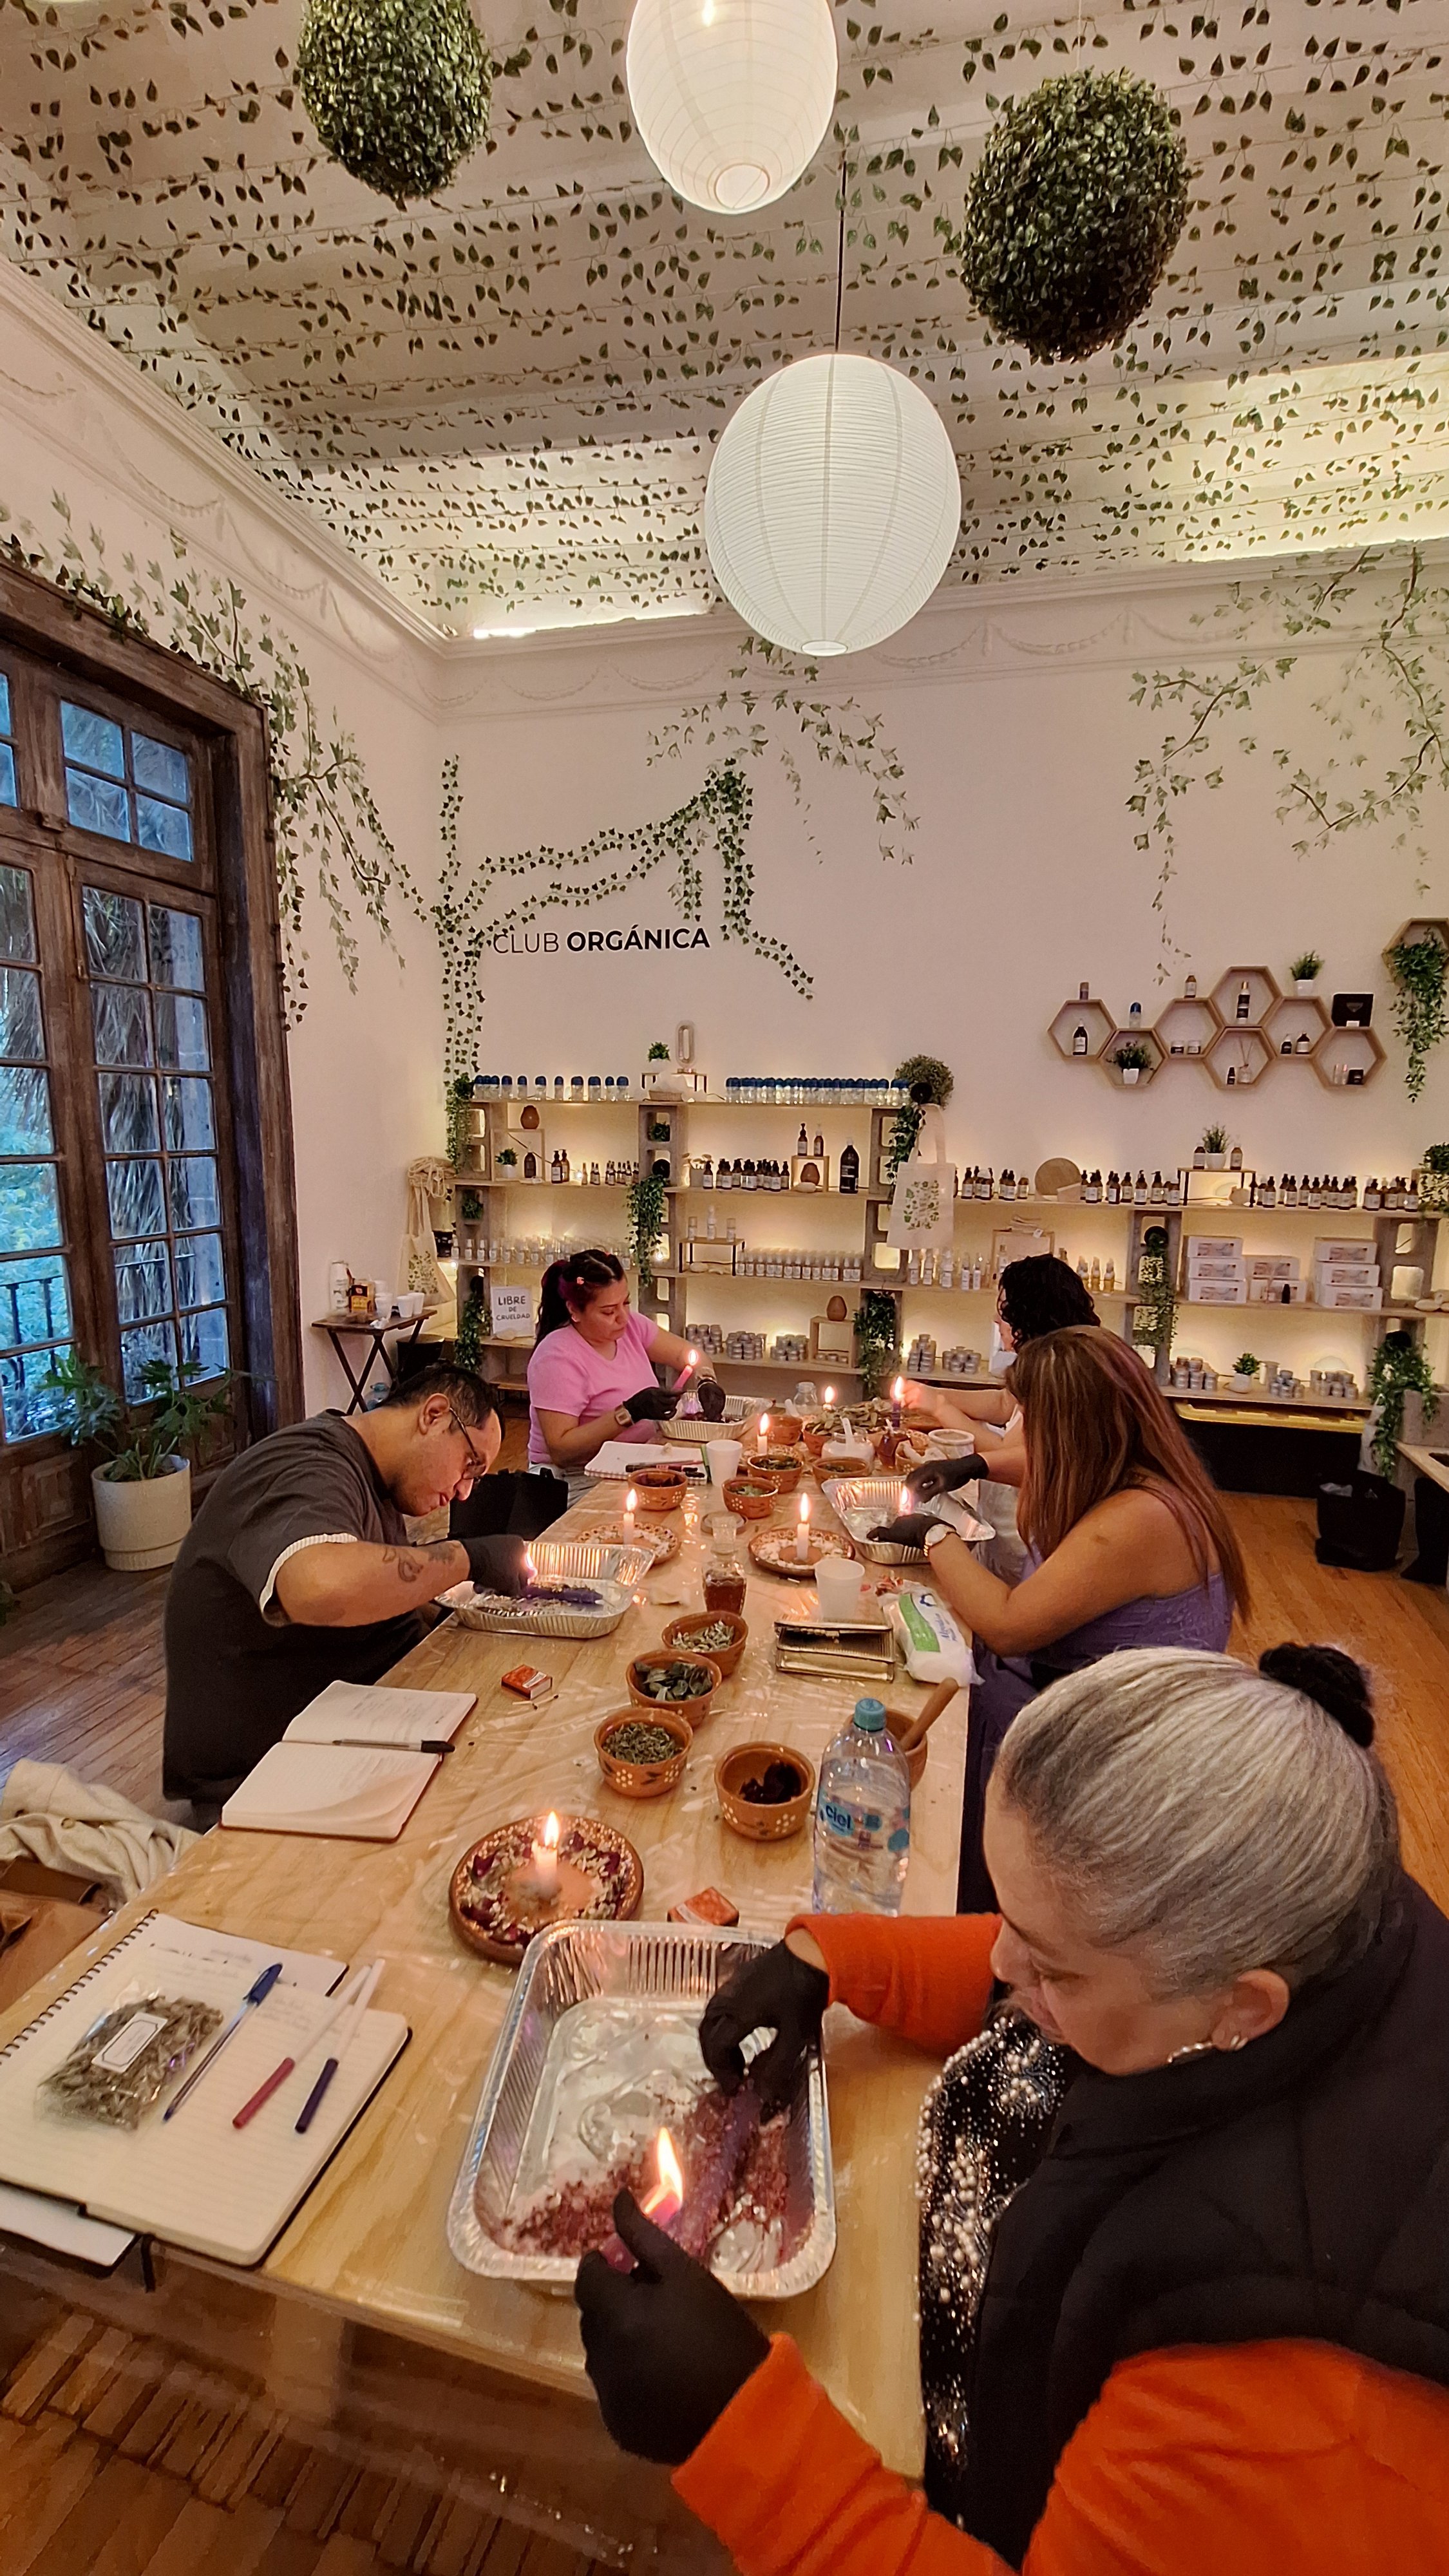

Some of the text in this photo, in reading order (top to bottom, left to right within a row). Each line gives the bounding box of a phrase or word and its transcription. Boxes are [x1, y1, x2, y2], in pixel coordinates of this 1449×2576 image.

[493, 924, 710, 954] CLUB ORGÁNICA
[498, 1295, 526, 1305] LIBRE
